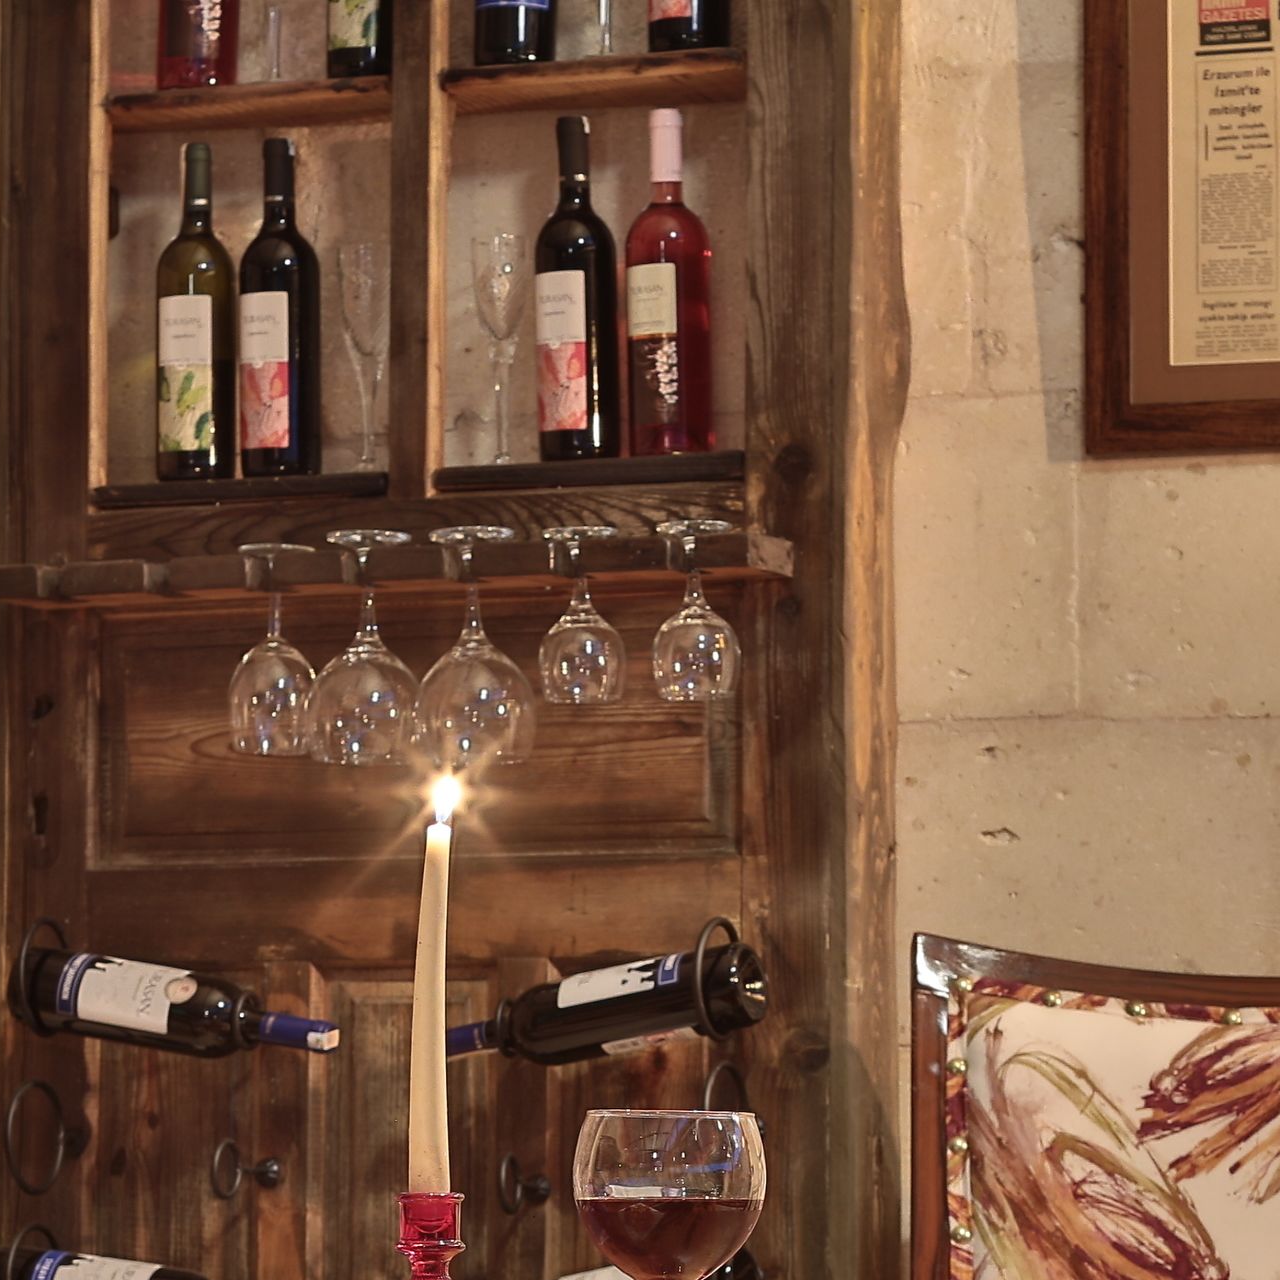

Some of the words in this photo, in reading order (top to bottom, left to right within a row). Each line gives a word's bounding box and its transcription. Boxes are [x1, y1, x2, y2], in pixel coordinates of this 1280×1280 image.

[1202, 68, 1253, 80] Erzurum
[1208, 102, 1263, 117] mitingler
[136, 973, 163, 1017] RASAN
